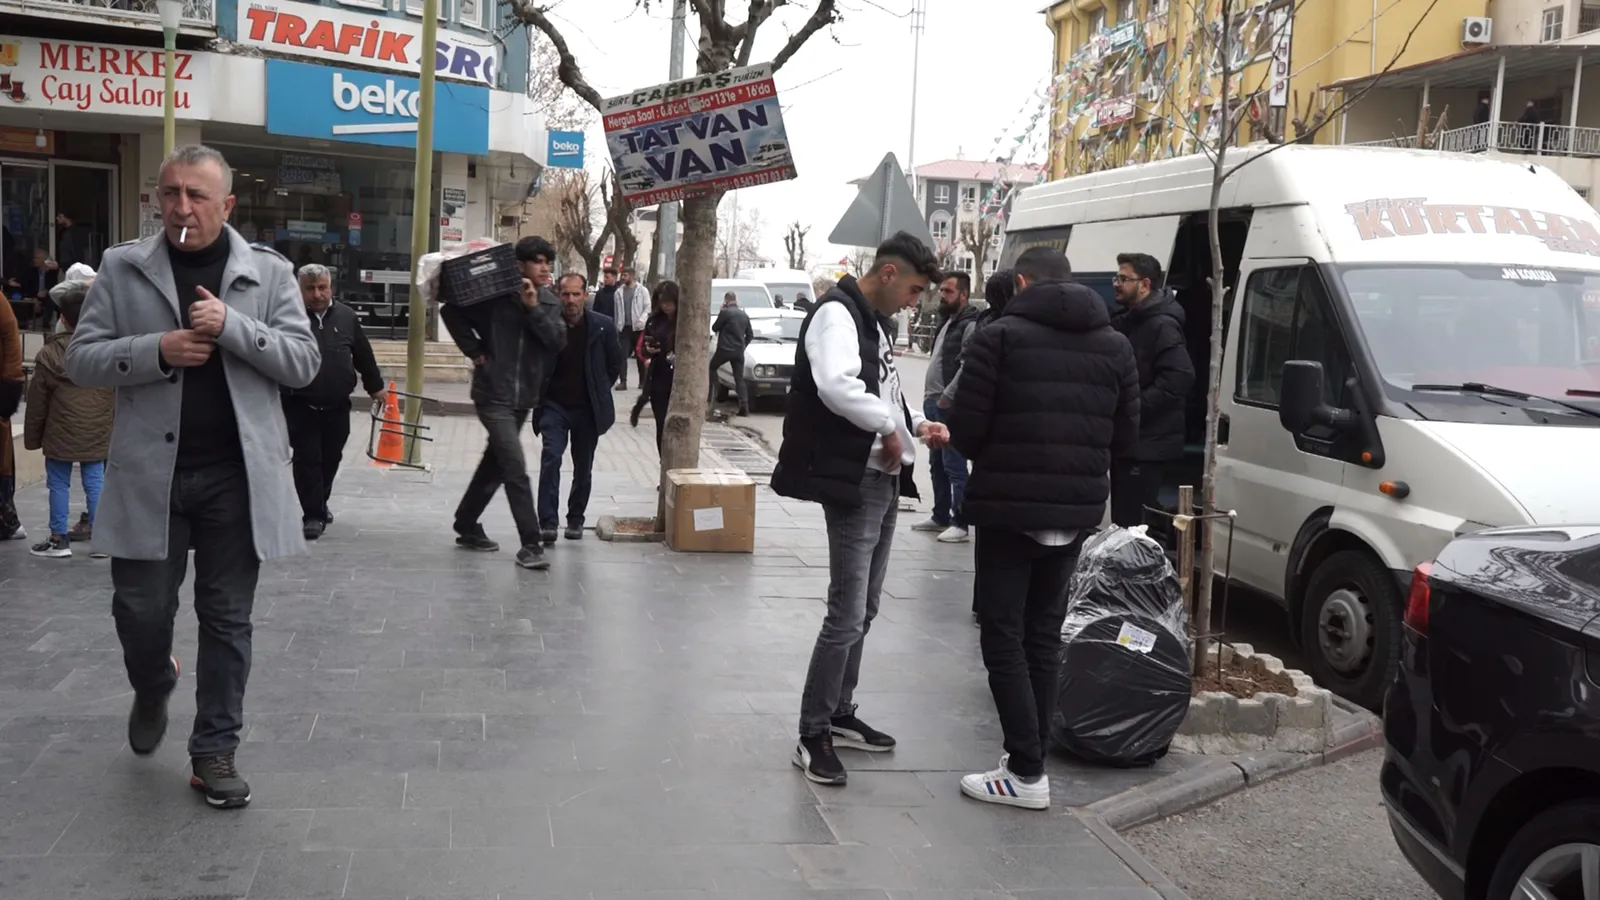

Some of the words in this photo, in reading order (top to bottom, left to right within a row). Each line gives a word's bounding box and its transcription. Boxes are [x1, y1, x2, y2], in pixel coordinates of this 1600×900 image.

[247, 8, 413, 64] TRAFİK
[39, 41, 193, 80] MERKEZ
[41, 74, 92, 110] Çay
[608, 112, 637, 128] Hergün
[619, 104, 769, 154] TATVAN
[552, 140, 580, 151] beko
[644, 138, 748, 182] VAN
